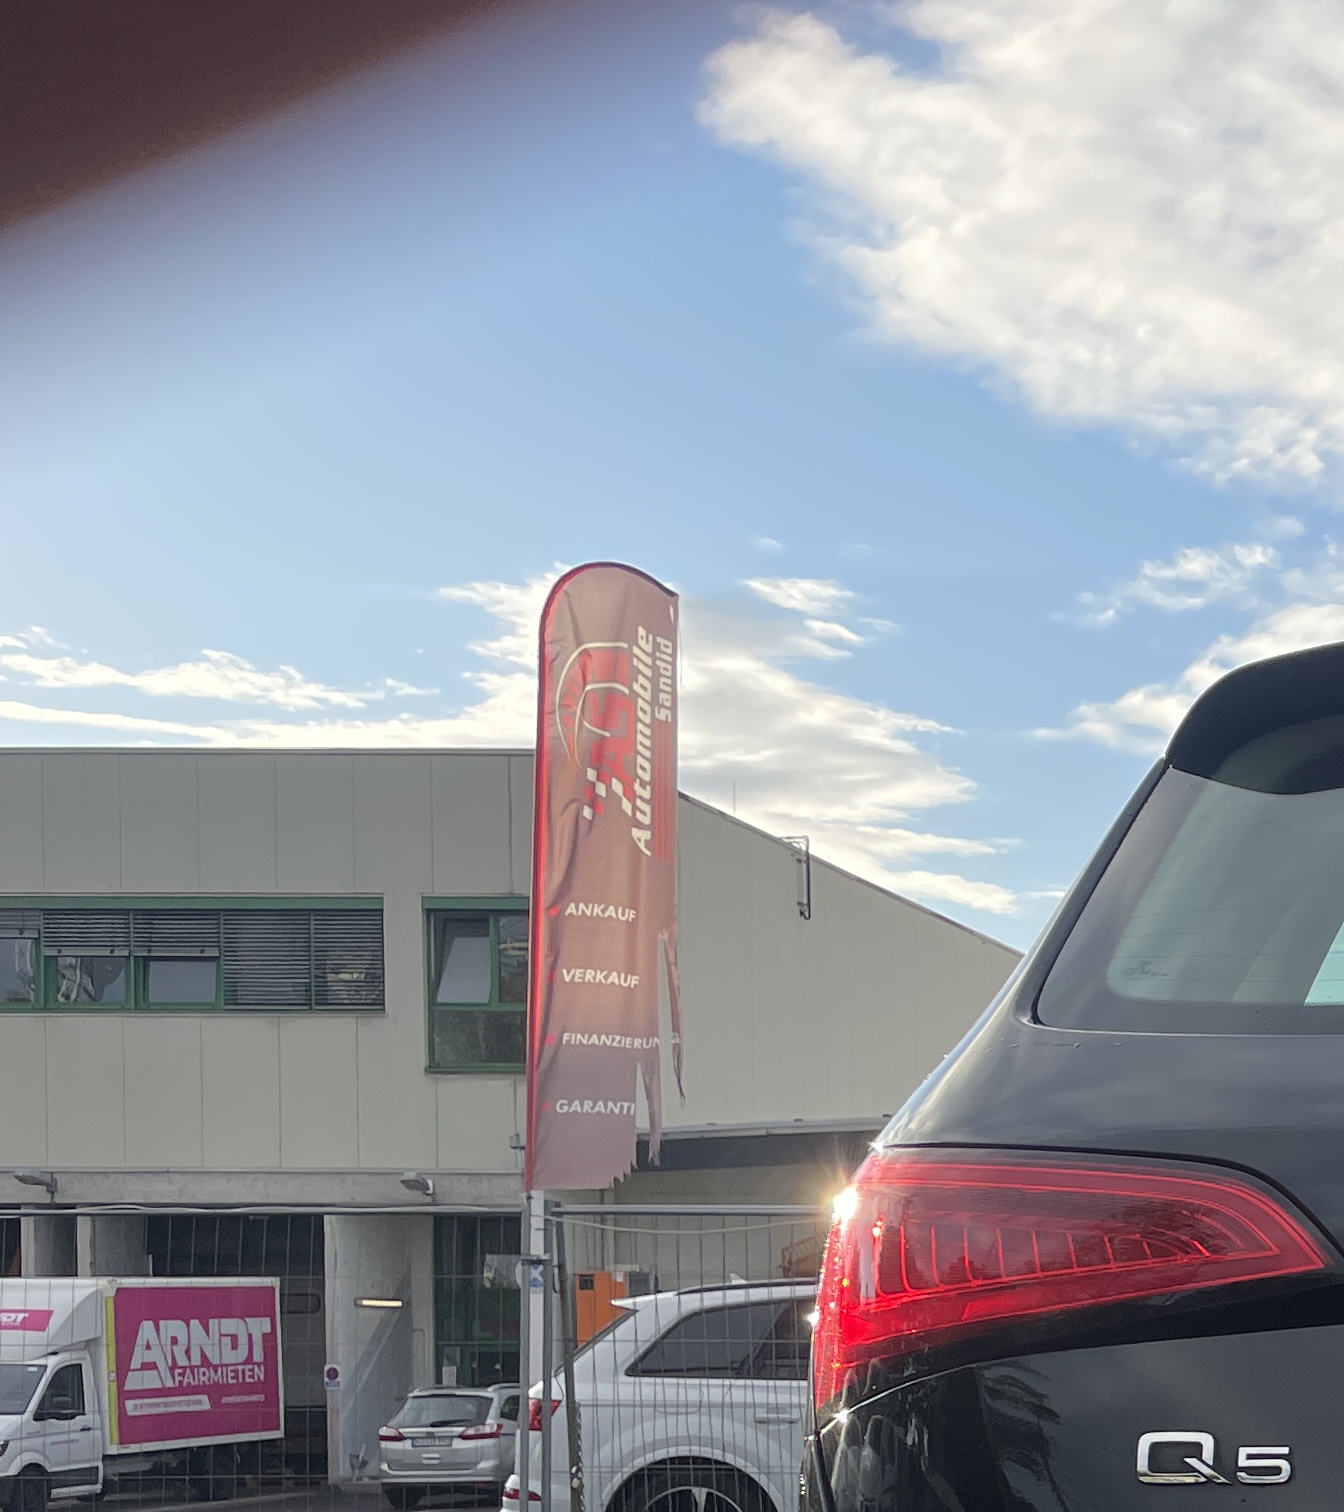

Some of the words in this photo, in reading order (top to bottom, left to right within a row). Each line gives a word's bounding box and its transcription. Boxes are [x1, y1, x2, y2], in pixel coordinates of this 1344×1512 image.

[655, 636, 673, 723] Sandid
[632, 625, 653, 857] Automobile
[564, 902, 637, 923] ANKAUF
[562, 968, 640, 989] VERKAUF
[123, 1316, 272, 1391] ARNDT
[174, 1364, 266, 1388] FAIRMIETEN
